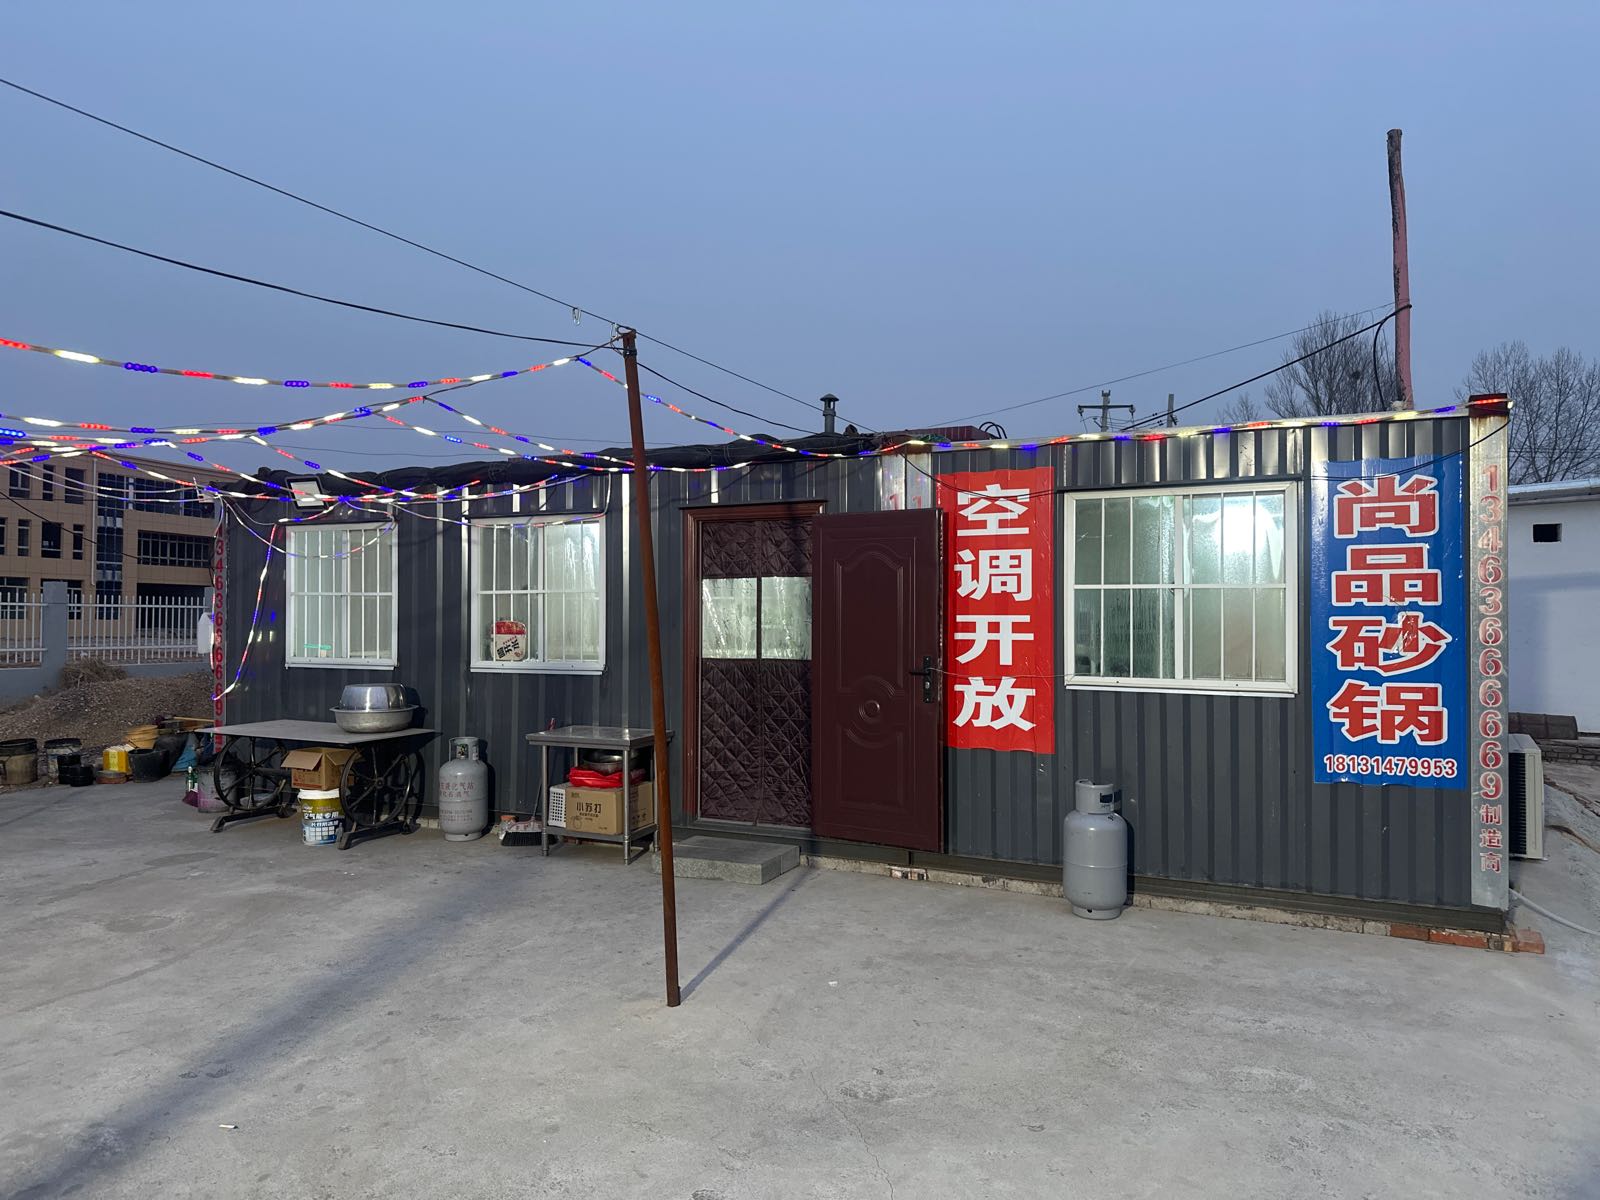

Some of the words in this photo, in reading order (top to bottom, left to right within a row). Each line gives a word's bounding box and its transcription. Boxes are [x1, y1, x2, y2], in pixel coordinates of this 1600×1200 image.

[953, 483, 1036, 732] 空调开放
[1327, 474, 1452, 746] 尚品砂锅
[576, 802, 602, 814] 小苏打
[1324, 754, 1458, 778] 18131479953
